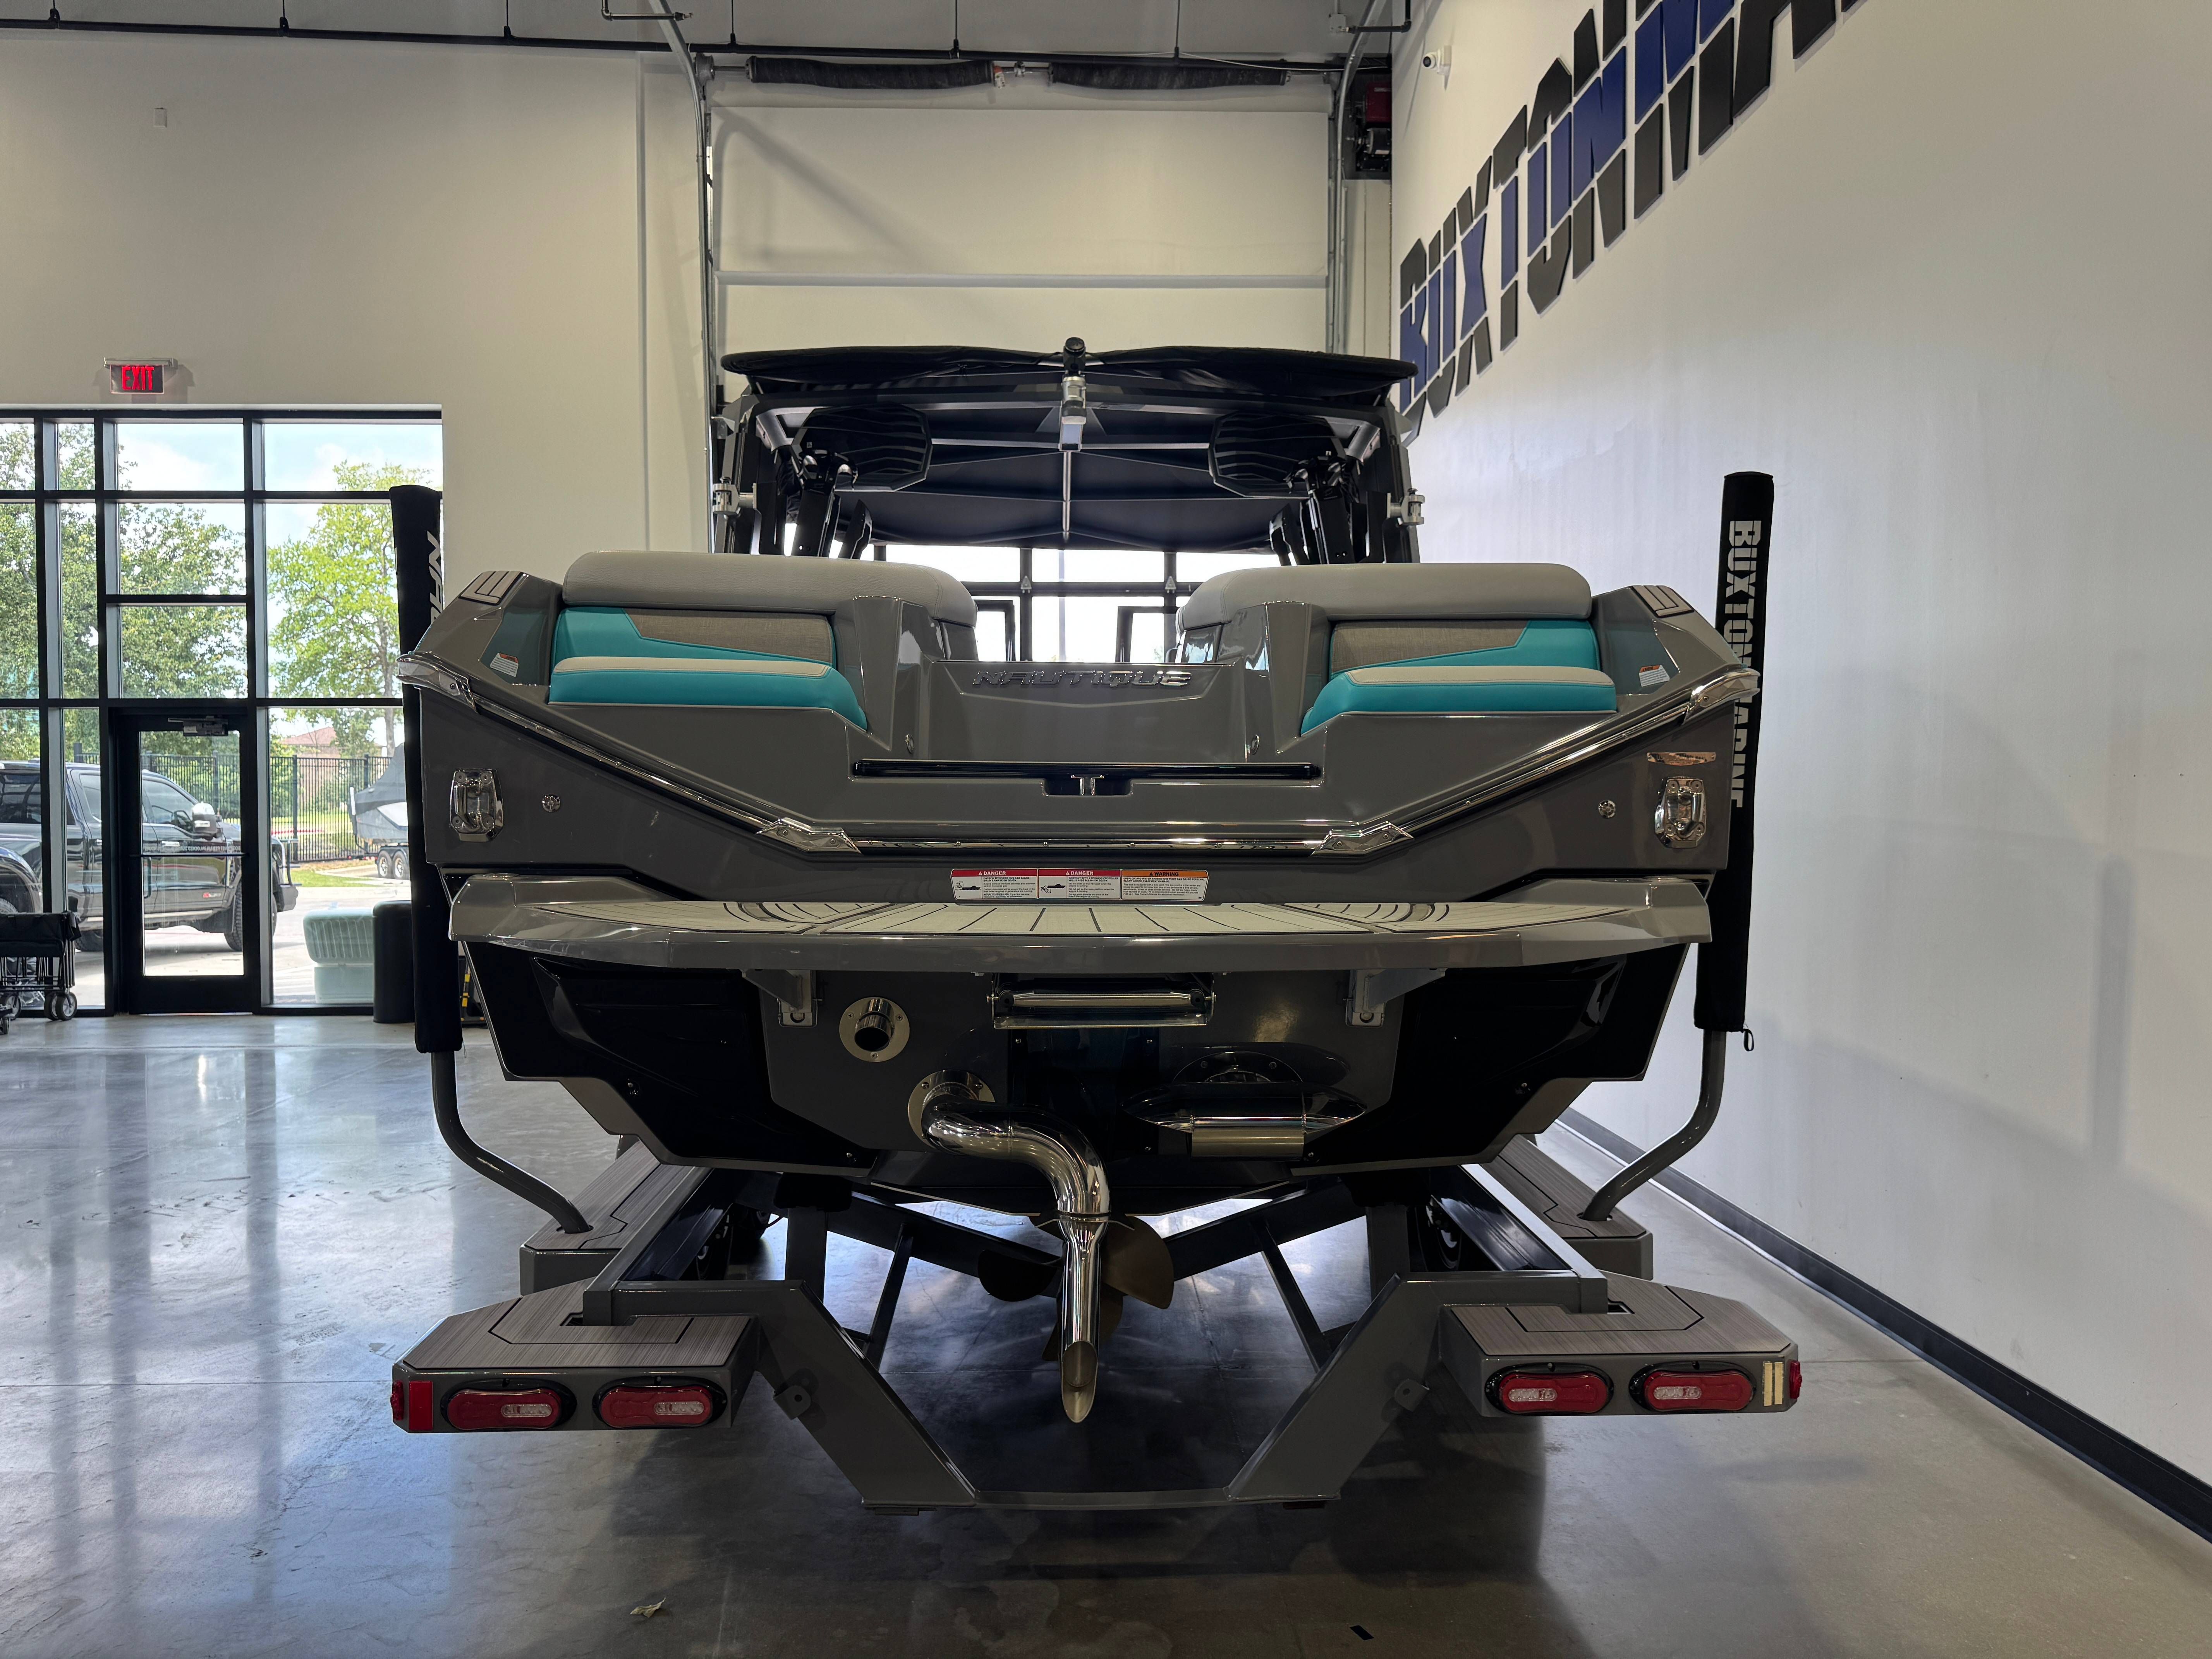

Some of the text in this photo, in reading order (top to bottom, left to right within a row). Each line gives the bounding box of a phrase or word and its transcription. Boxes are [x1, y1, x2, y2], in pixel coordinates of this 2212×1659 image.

[1400, 0, 1626, 447] BUXTON
[122, 366, 155, 390] EXIT
[972, 670, 1192, 688] NAUTIQUE
